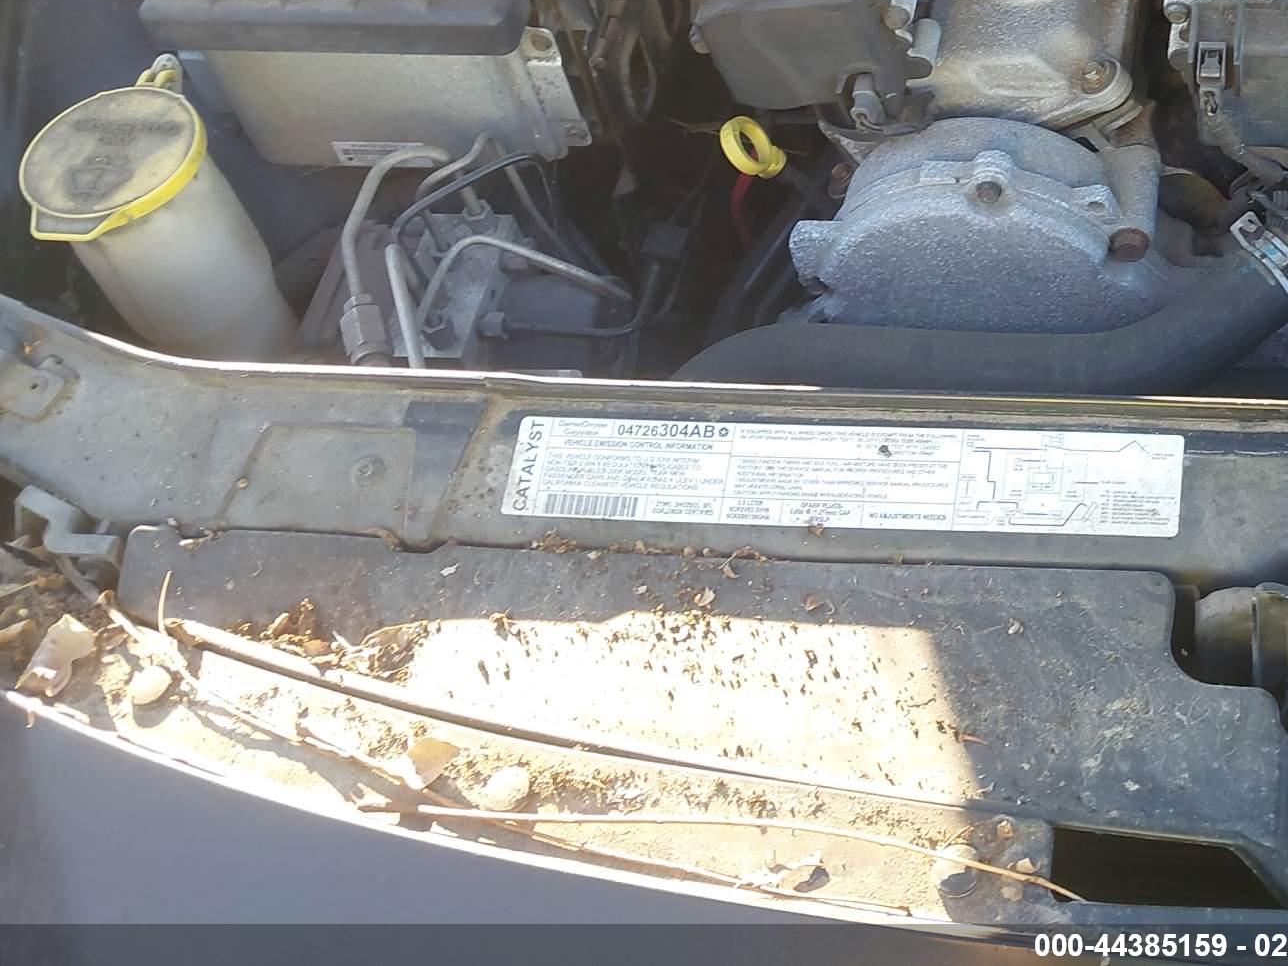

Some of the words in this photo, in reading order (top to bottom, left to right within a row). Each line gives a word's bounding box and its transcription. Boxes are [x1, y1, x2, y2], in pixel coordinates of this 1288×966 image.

[617, 423, 715, 439] 04726304AB
[629, 441, 662, 449] CONTROL
[664, 442, 714, 451] INFORMATION
[512, 420, 545, 511] CATALYST
